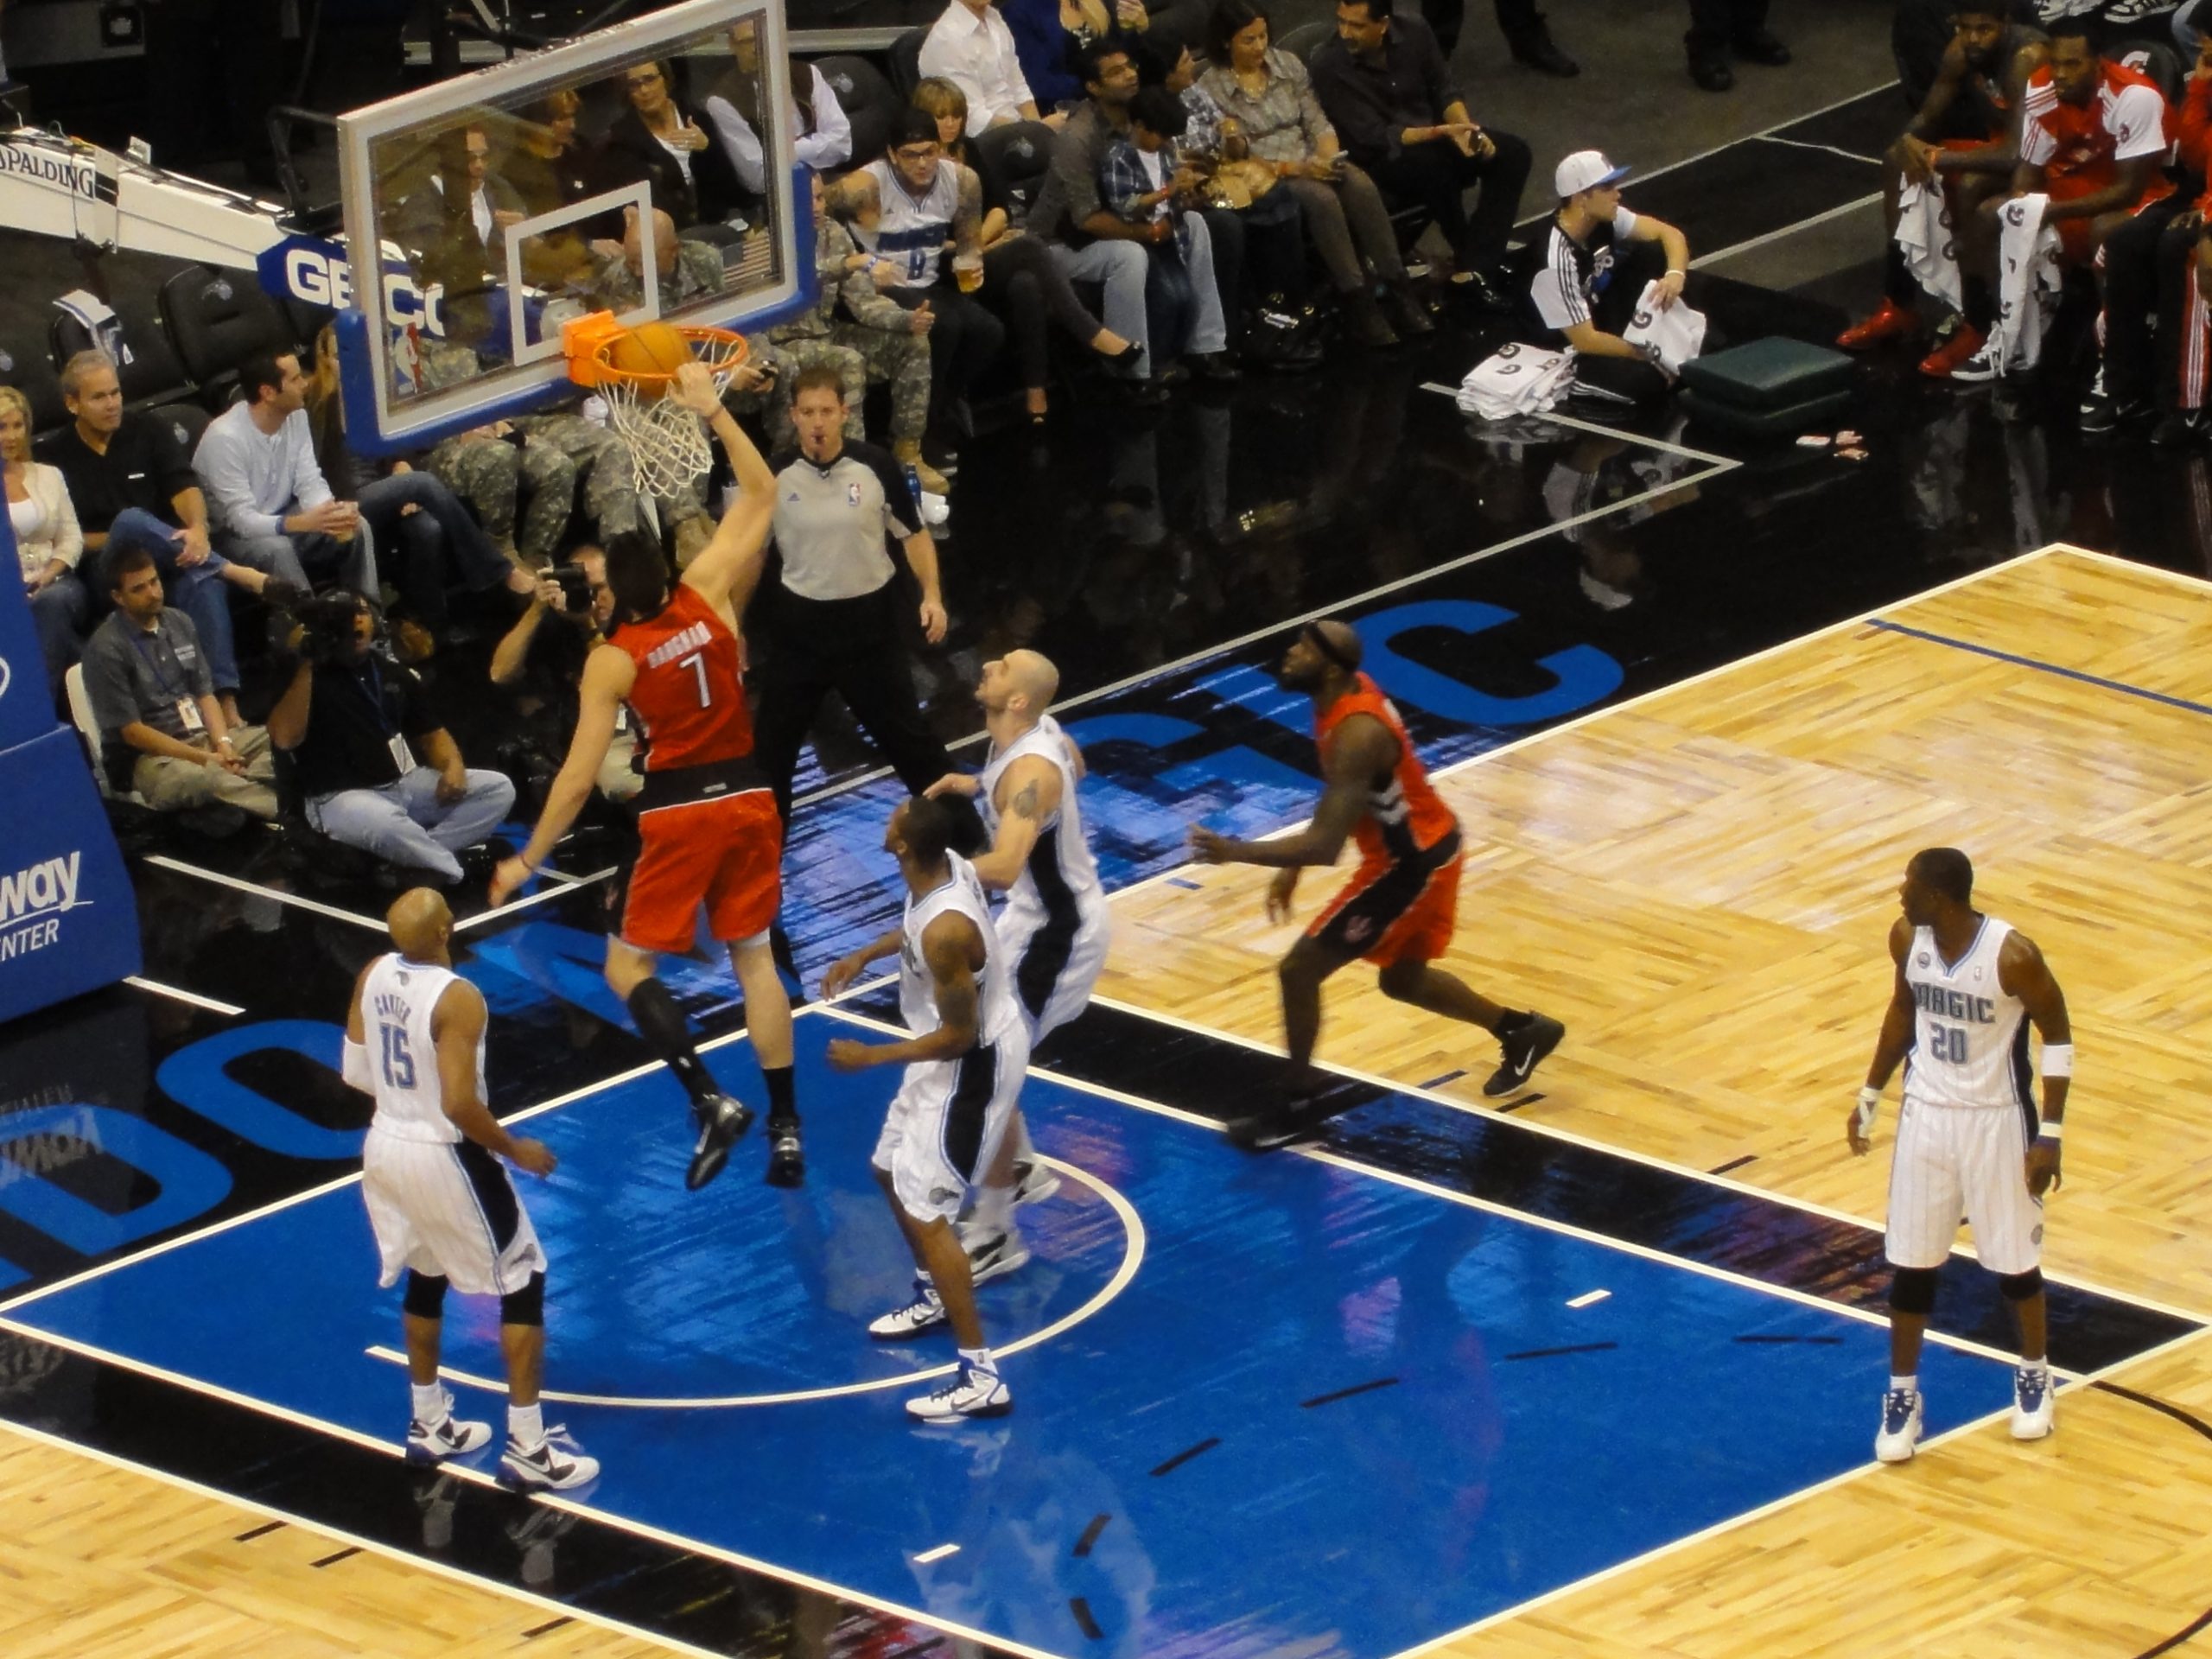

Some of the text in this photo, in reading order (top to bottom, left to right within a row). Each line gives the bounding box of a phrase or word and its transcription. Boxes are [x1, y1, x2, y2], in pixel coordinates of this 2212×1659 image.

[286, 248, 446, 338] GECO
[678, 652, 712, 709] 7
[0, 918, 60, 962] NTER
[1912, 982, 1997, 1024] MAGIC
[379, 1021, 418, 1090] 15
[1929, 1020, 1968, 1065] 20
